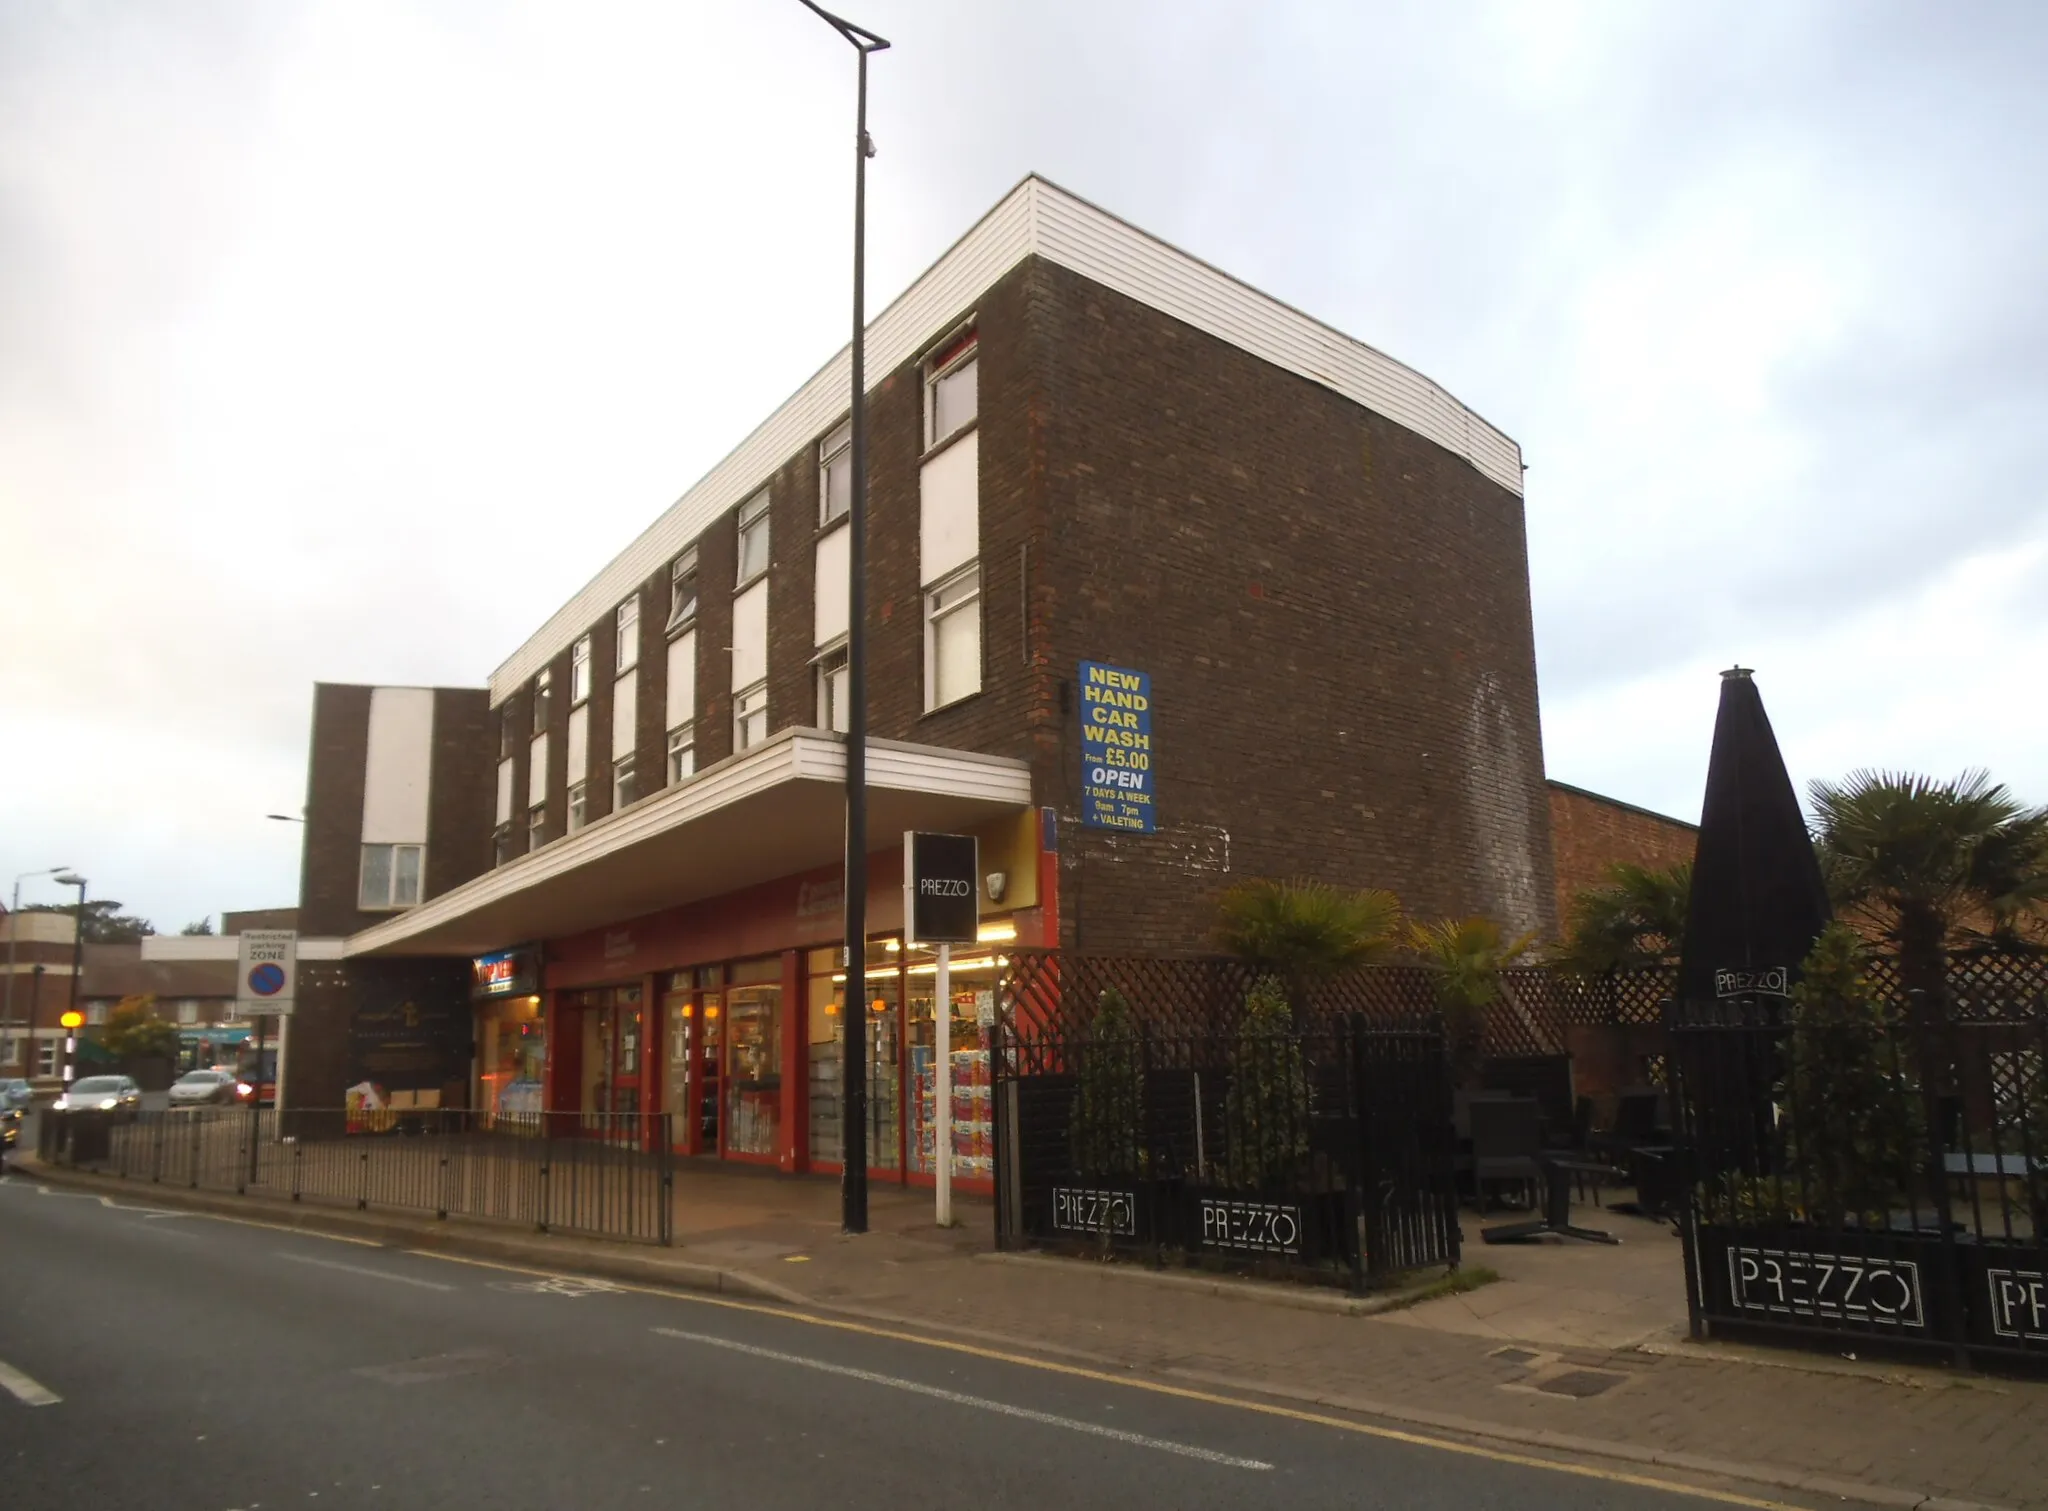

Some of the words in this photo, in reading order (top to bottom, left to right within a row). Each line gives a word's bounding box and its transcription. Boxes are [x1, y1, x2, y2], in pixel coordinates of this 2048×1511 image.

[1089, 666, 1140, 691] NEW
[1084, 685, 1148, 711] HAND
[1092, 707, 1138, 729] CAR
[1083, 724, 1149, 750] WASH
[1085, 753, 1103, 763] From
[1105, 747, 1149, 771] £5.00
[1091, 767, 1144, 790] OPEN
[1084, 785, 1090, 796] 7
[1092, 787, 1116, 799] DAYS
[1117, 790, 1124, 801] A
[1125, 791, 1151, 804] WEEK
[1120, 803, 1139, 816] 7pm
[1100, 813, 1144, 829] VALETING
[920, 878, 969, 897] PREZZO
[249, 951, 285, 960] ZONE
[1717, 971, 1782, 992] PREZZO
[1203, 1206, 1296, 1245] PREZZO
[1740, 1257, 1911, 1313] PREZZO
